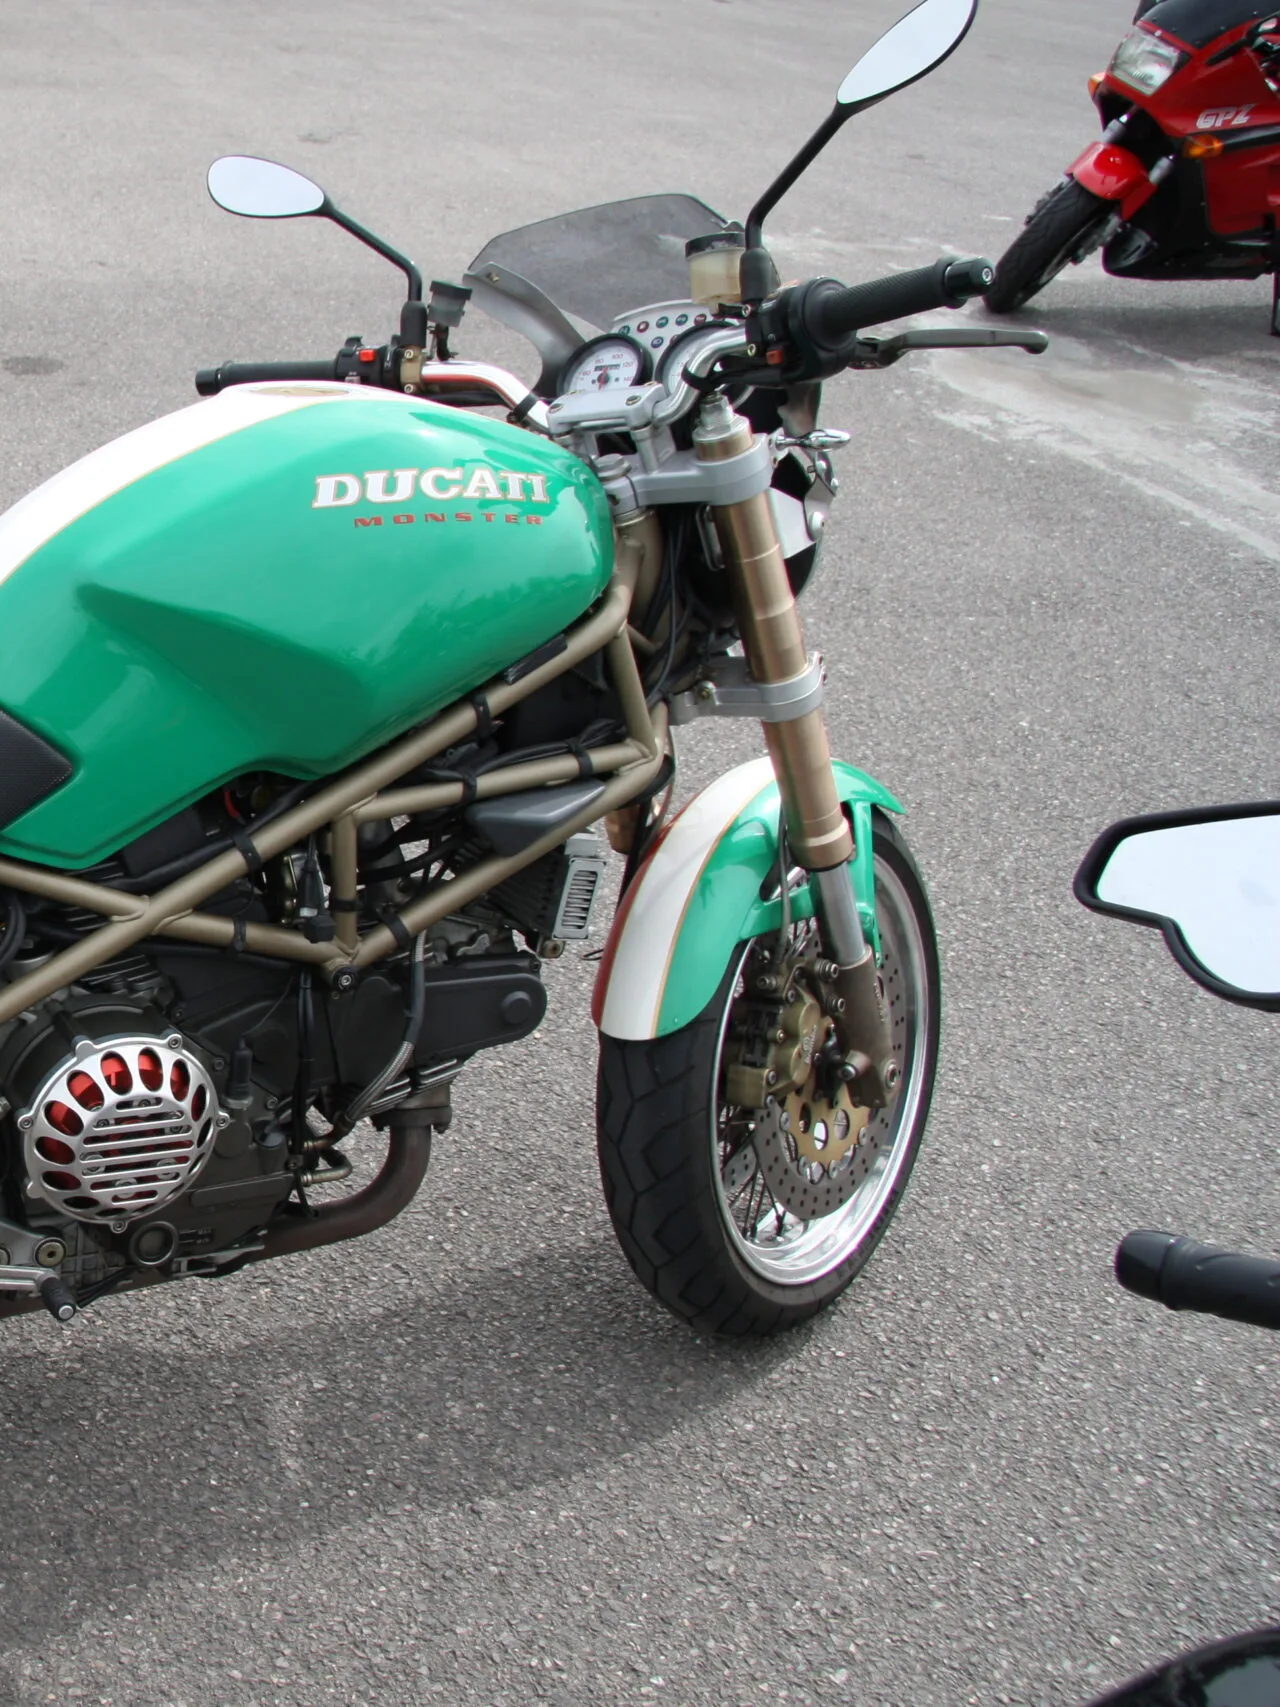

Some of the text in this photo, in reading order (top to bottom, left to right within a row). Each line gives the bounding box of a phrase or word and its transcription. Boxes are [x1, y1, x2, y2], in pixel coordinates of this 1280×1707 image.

[1196, 102, 1258, 129] GPZ
[312, 467, 550, 508] DUCATI
[354, 512, 542, 528] MONSTER
